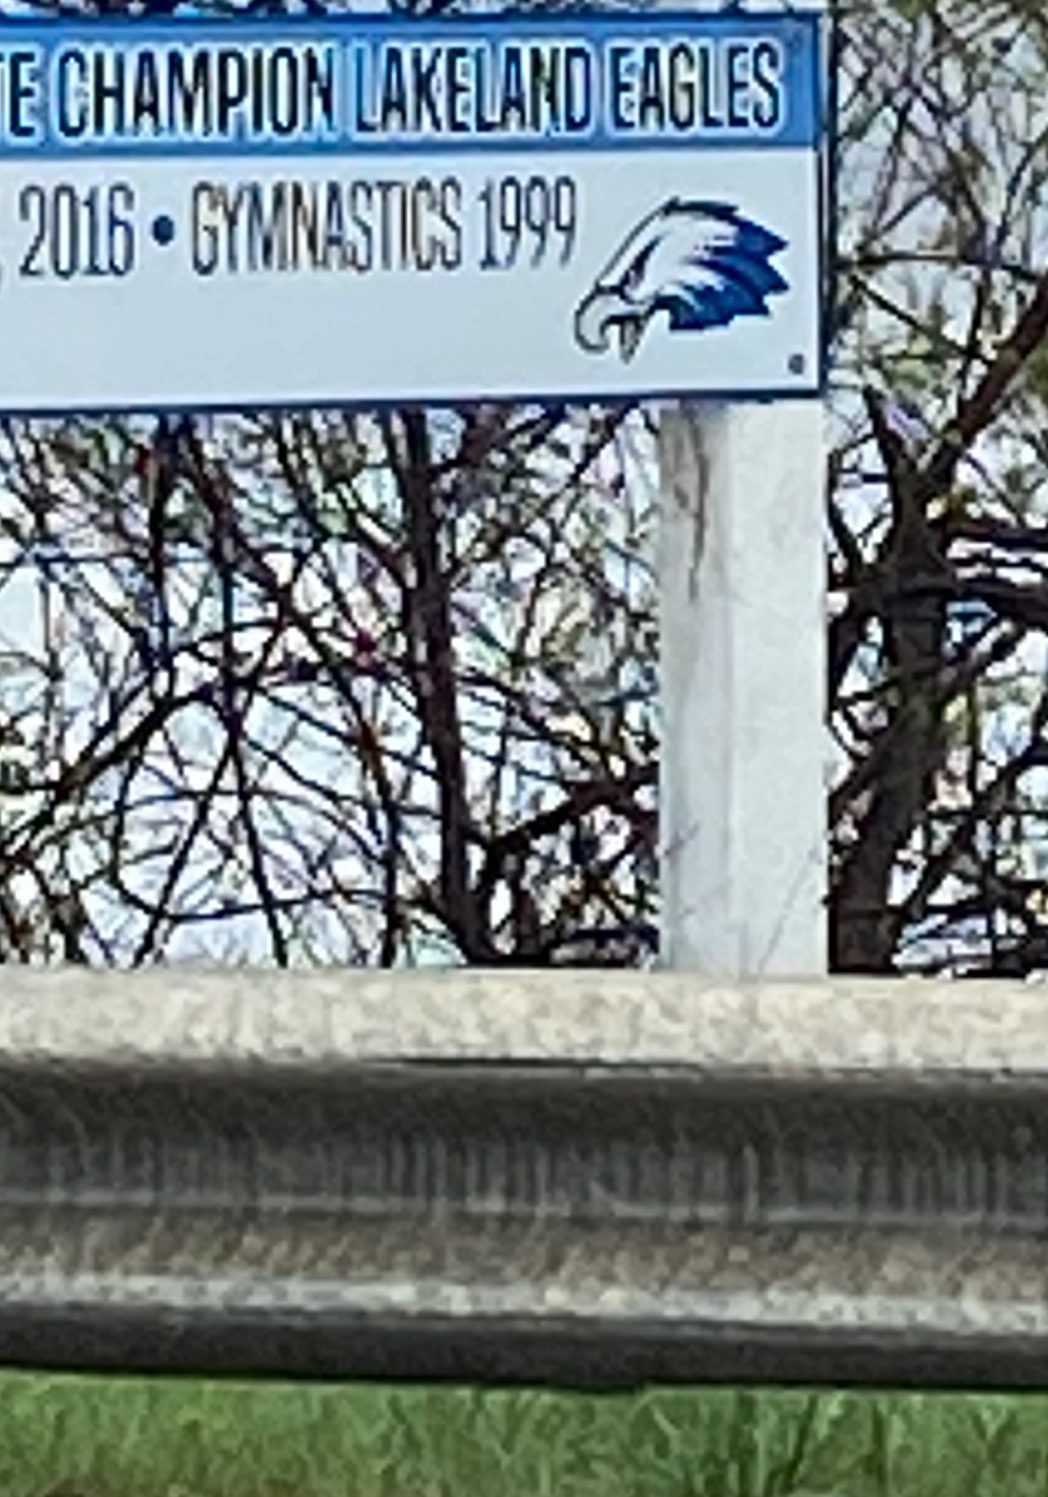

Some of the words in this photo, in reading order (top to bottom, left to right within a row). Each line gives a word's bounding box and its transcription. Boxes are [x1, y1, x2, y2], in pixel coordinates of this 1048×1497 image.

[57, 47, 333, 137] CHAMPION
[355, 45, 591, 133] LAKELAND
[612, 41, 781, 129] EAGLES
[16, 184, 136, 279] 2016
[191, 176, 462, 276] GYMNASTICS
[478, 175, 577, 271] 1999
